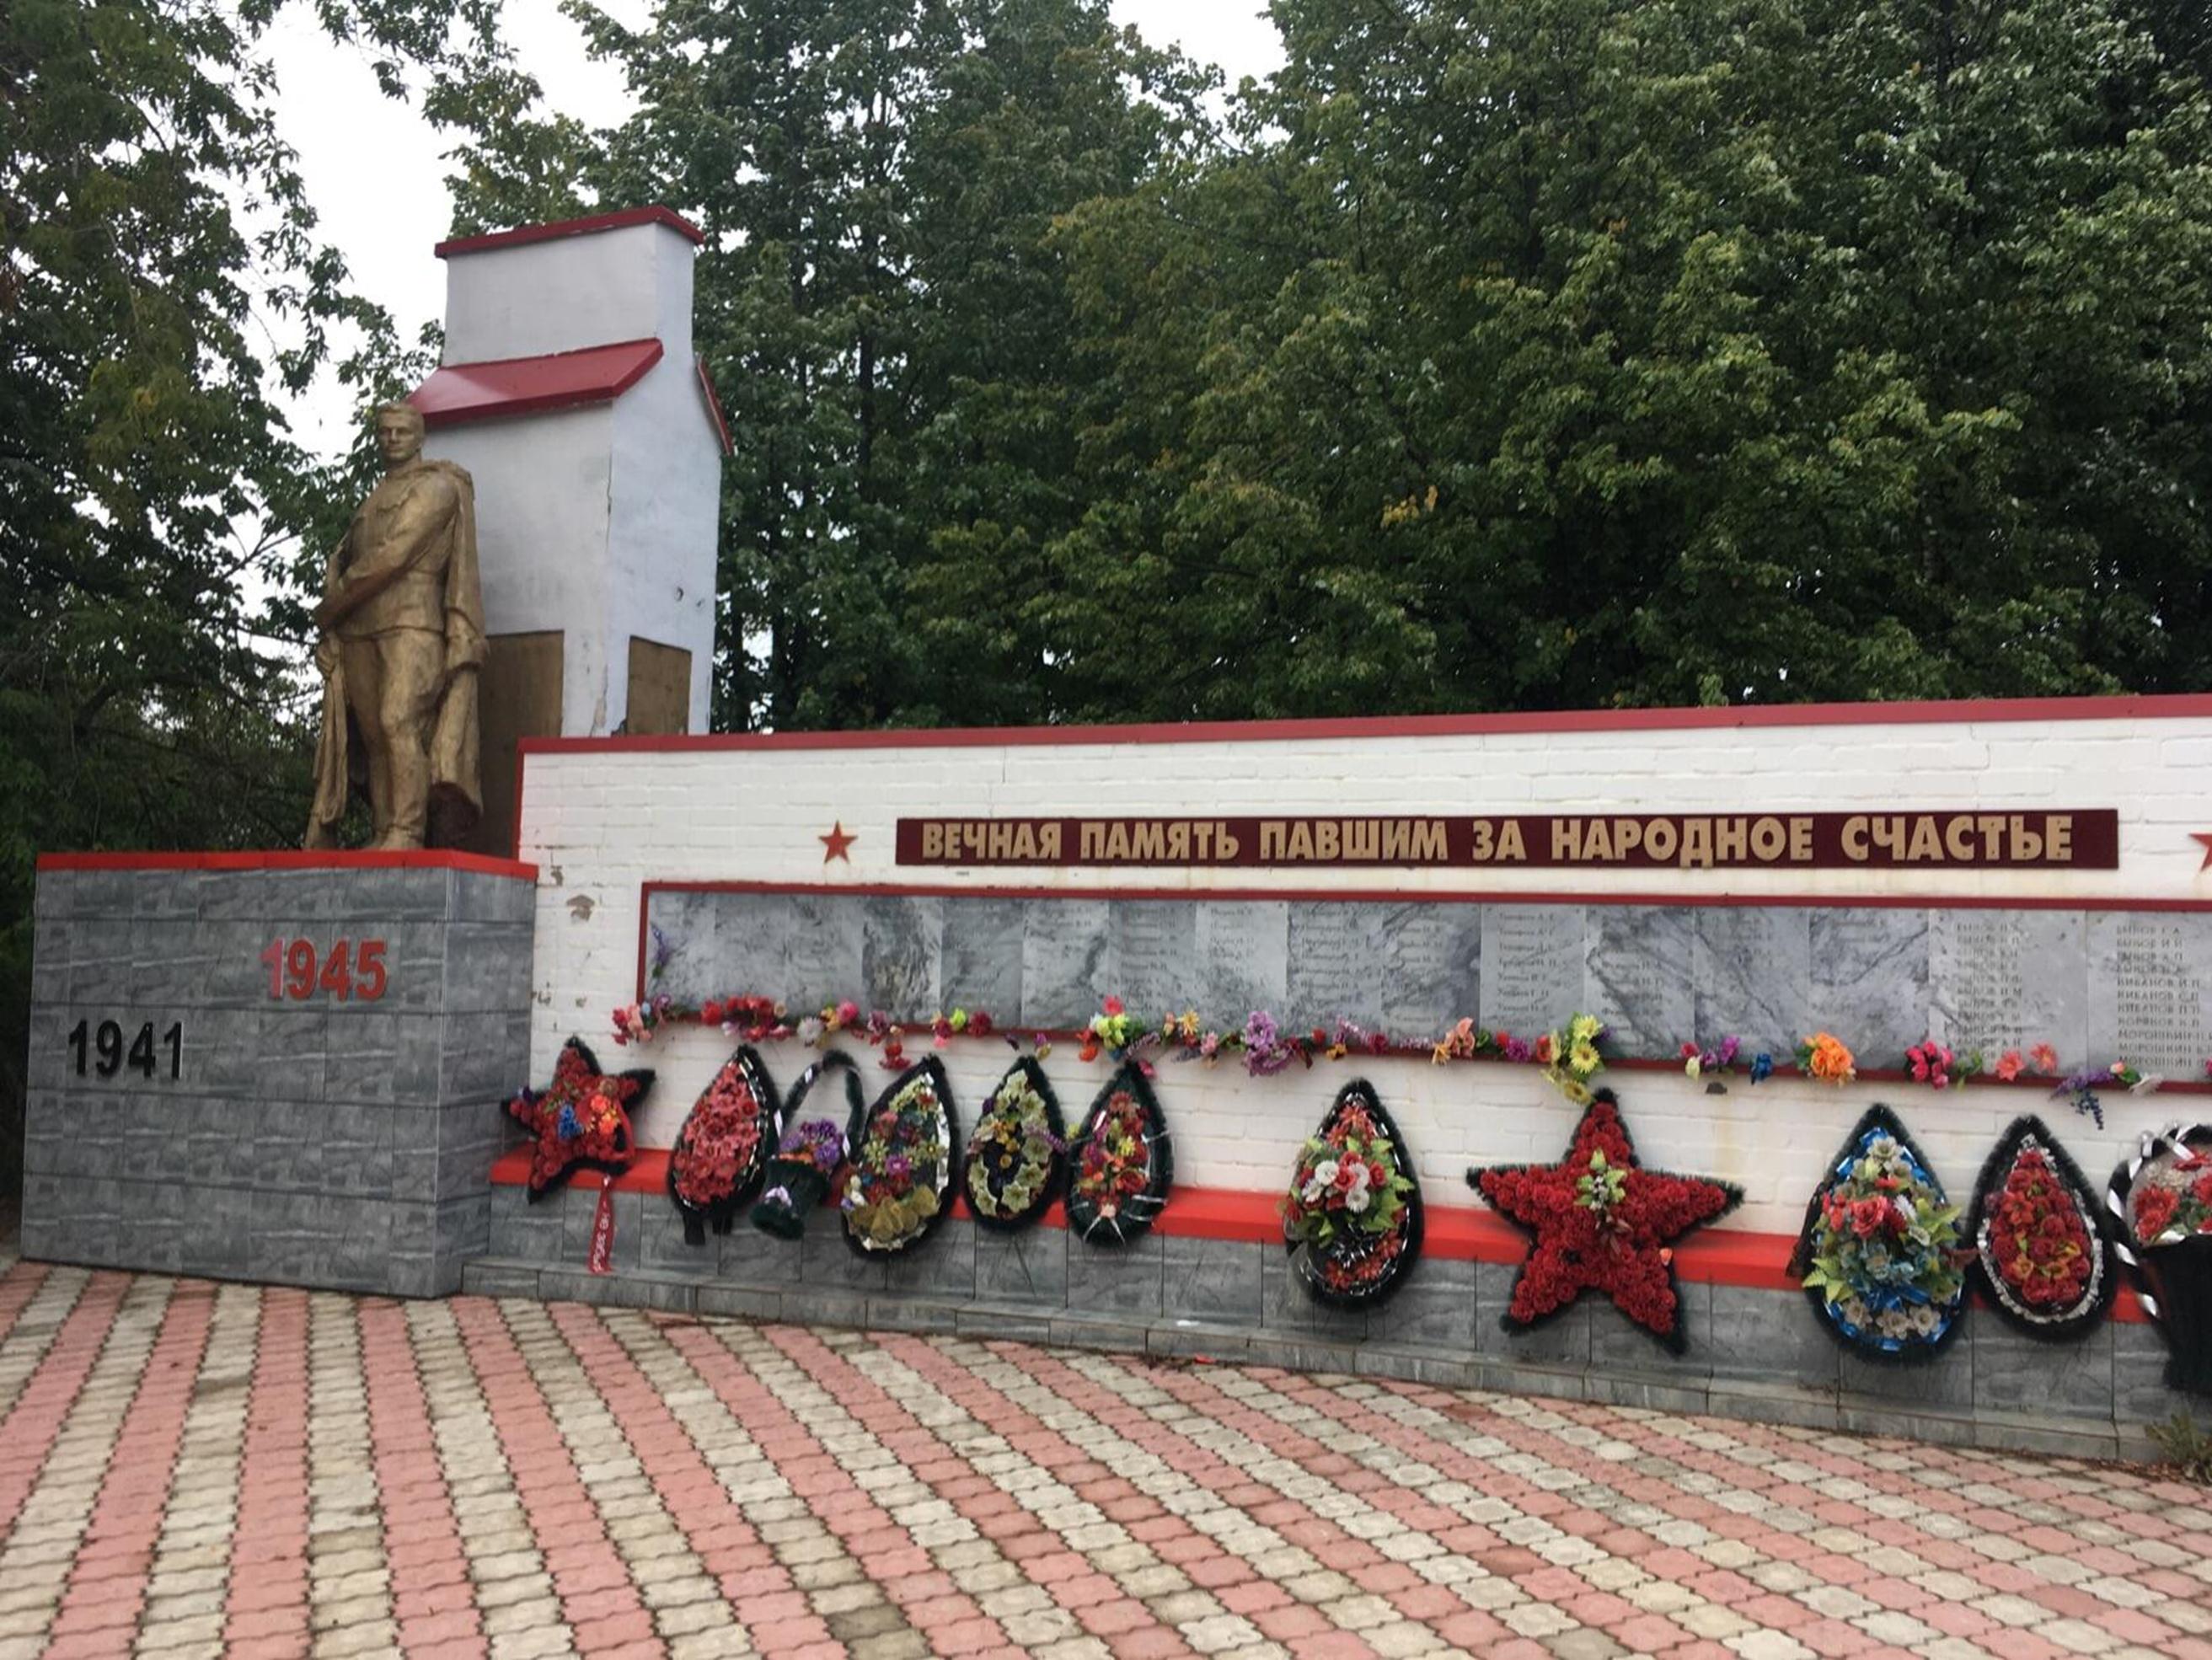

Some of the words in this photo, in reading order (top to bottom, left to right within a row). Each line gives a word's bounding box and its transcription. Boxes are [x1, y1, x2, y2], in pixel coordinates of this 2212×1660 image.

[922, 822, 1062, 859] ВЕЧНАЯ
[1079, 821, 1240, 859] ПАМЯТЬ
[1260, 820, 1449, 860] ПАВШИМ
[1472, 819, 1527, 860] ЗА
[1551, 817, 1813, 868] НАРОДНОЕ
[1841, 816, 2073, 861] СЧАСТЬЕ
[260, 938, 389, 1001] 1945
[68, 1019, 185, 1079] 1941
